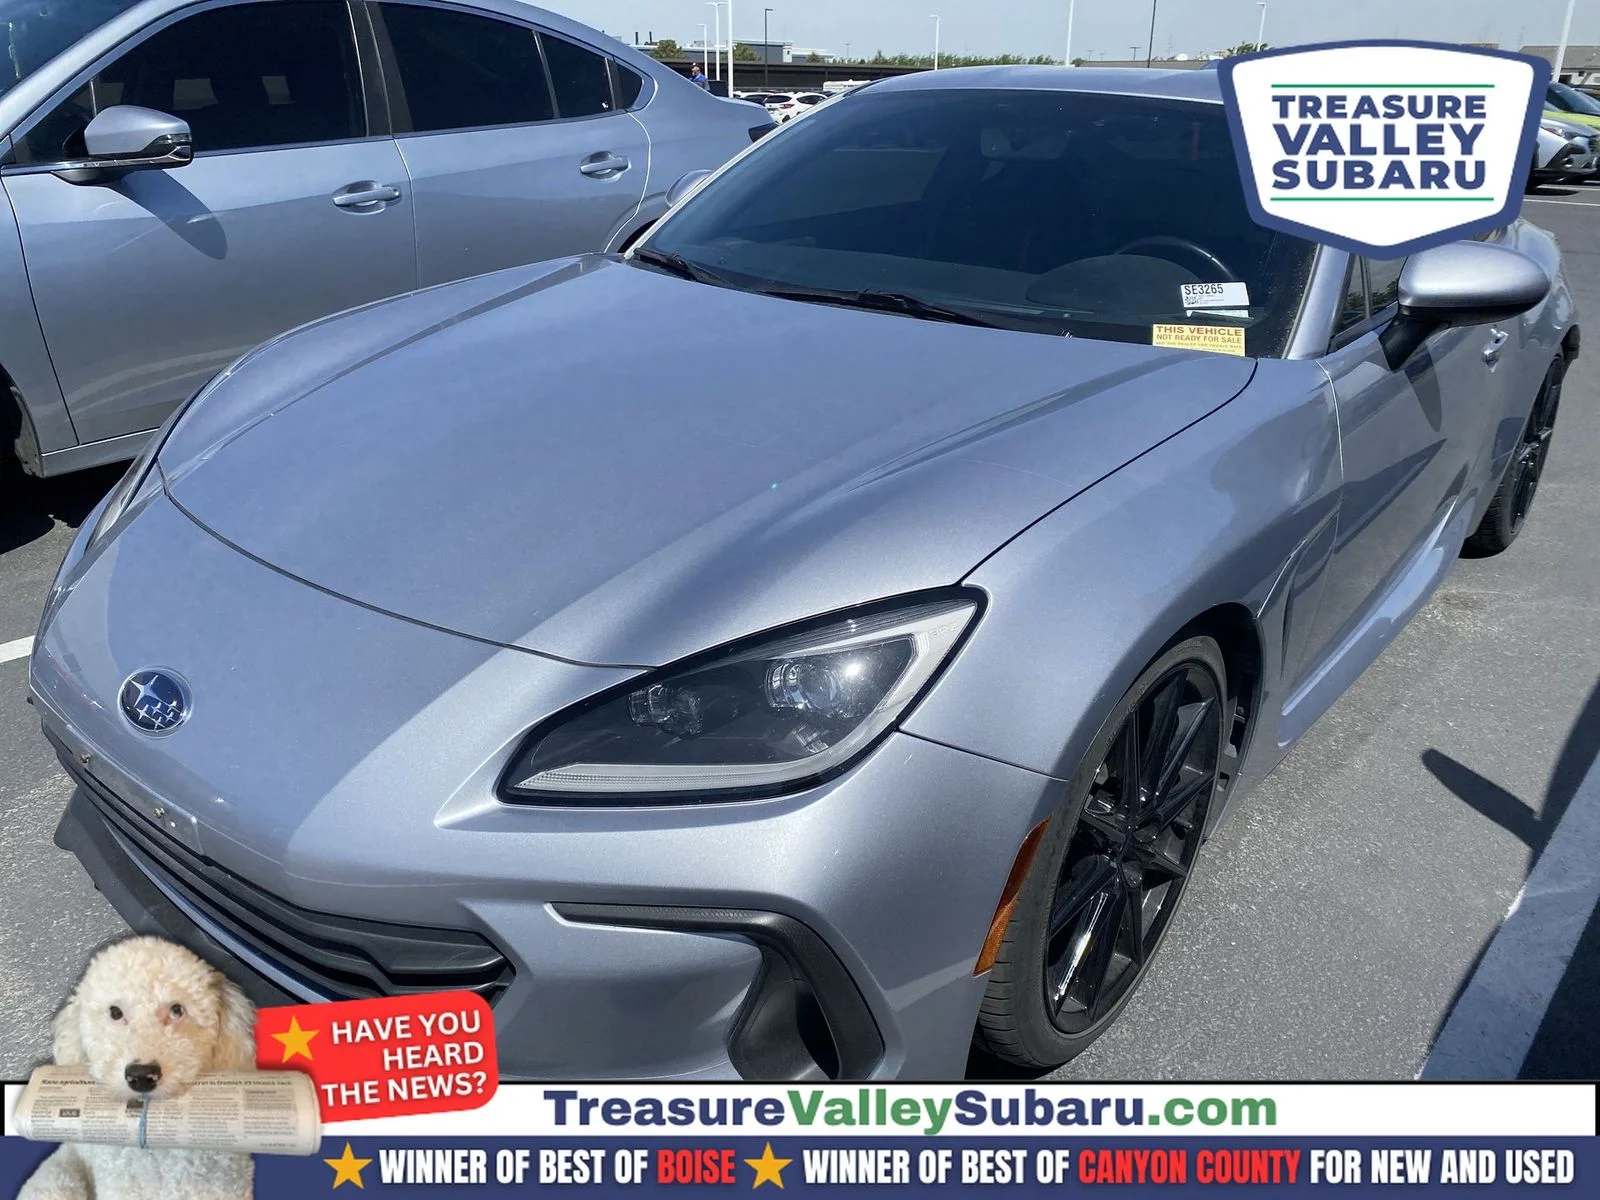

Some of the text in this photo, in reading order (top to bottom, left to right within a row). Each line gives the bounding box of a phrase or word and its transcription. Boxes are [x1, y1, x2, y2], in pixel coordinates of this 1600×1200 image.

[1184, 283, 1224, 295] SE3265
[1156, 325, 1242, 337] THIS VEHICLE
[1156, 333, 1242, 344] NOT READY FOR SALE
